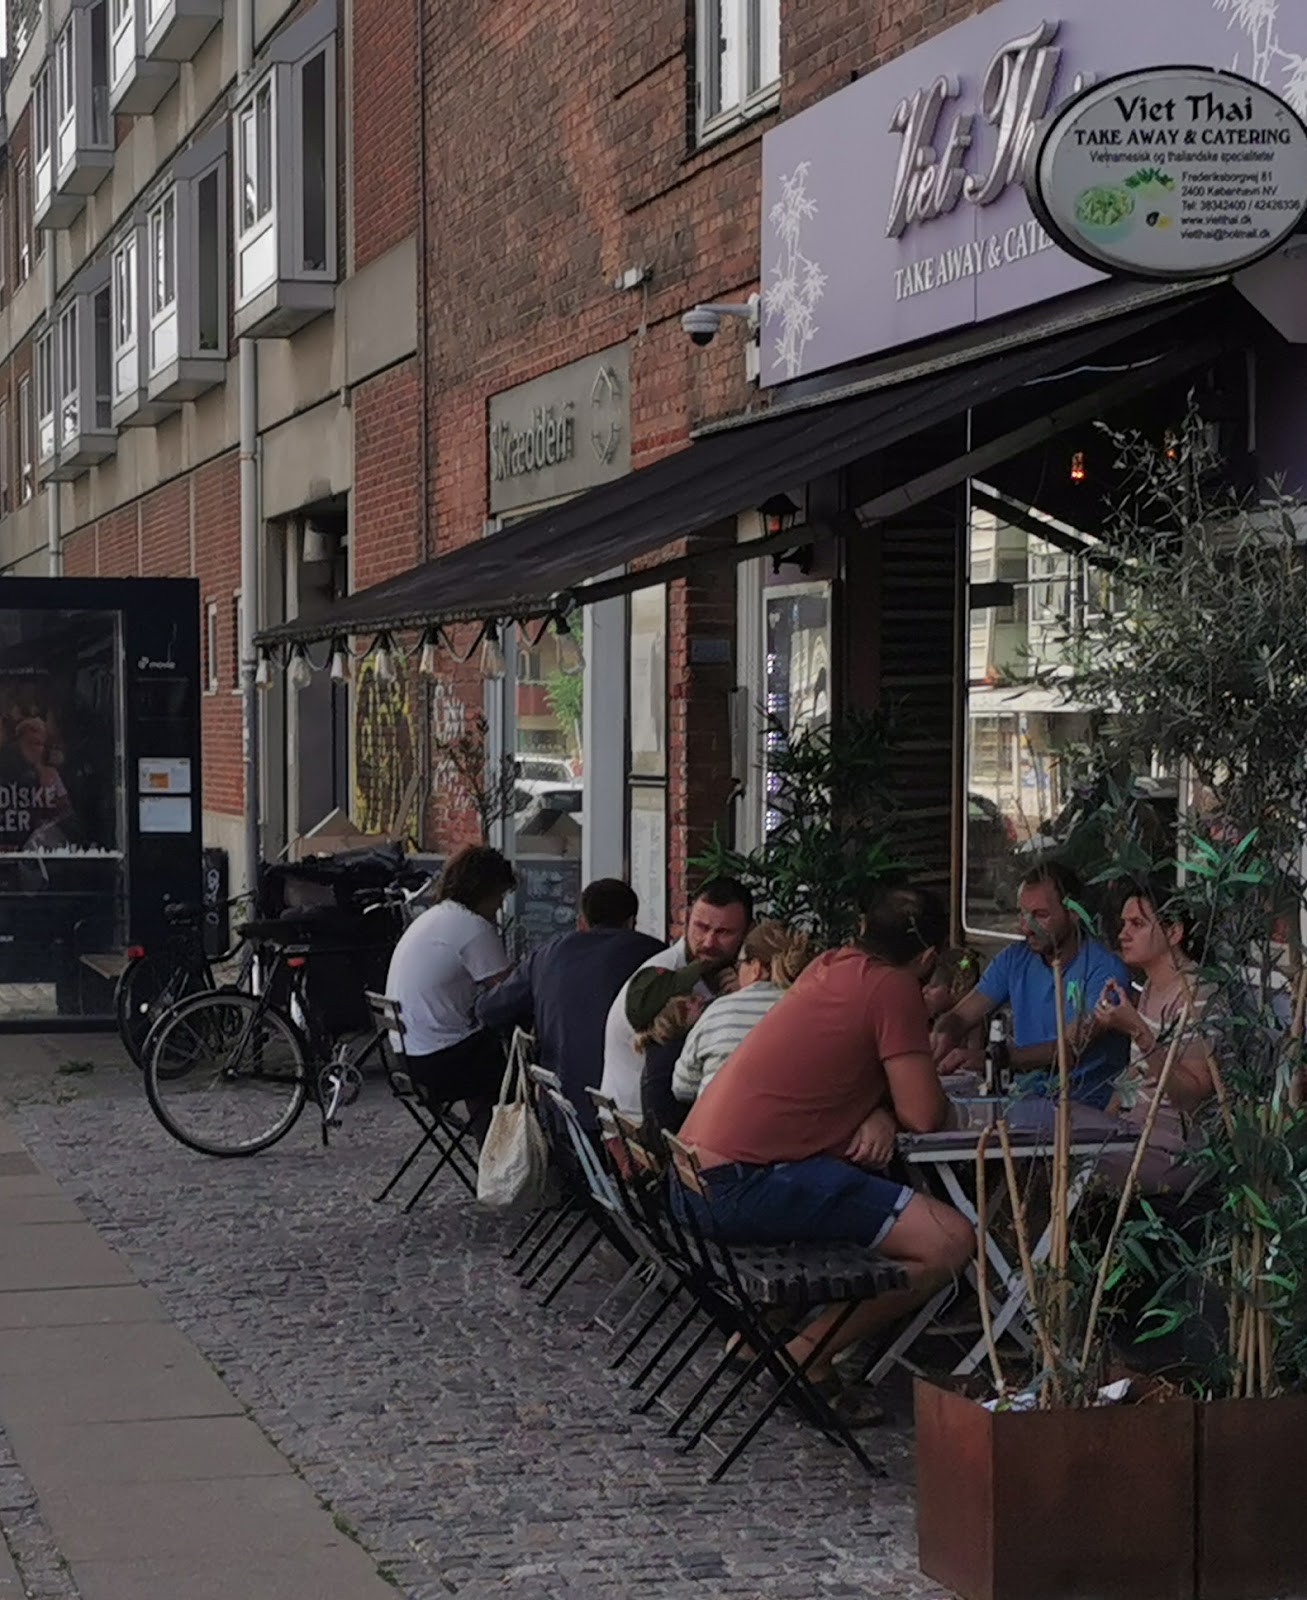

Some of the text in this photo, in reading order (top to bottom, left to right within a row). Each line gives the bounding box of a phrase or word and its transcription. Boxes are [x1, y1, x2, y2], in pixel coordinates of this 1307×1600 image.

[1114, 92, 1253, 123] Viet Thai
[1074, 128, 1291, 146] TAKE AWAY & CATERING
[885, 74, 970, 239] Viet
[1090, 151, 1275, 165] Vietnamesisk og thailandske specialiteter
[1181, 171, 1259, 185] Frederiksborgvej
[1181, 186, 1205, 197] 2400
[1262, 186, 1278, 196] NV
[893, 257, 935, 302] TAKE
[936, 238, 986, 287] AWAY
[988, 235, 1002, 269] &
